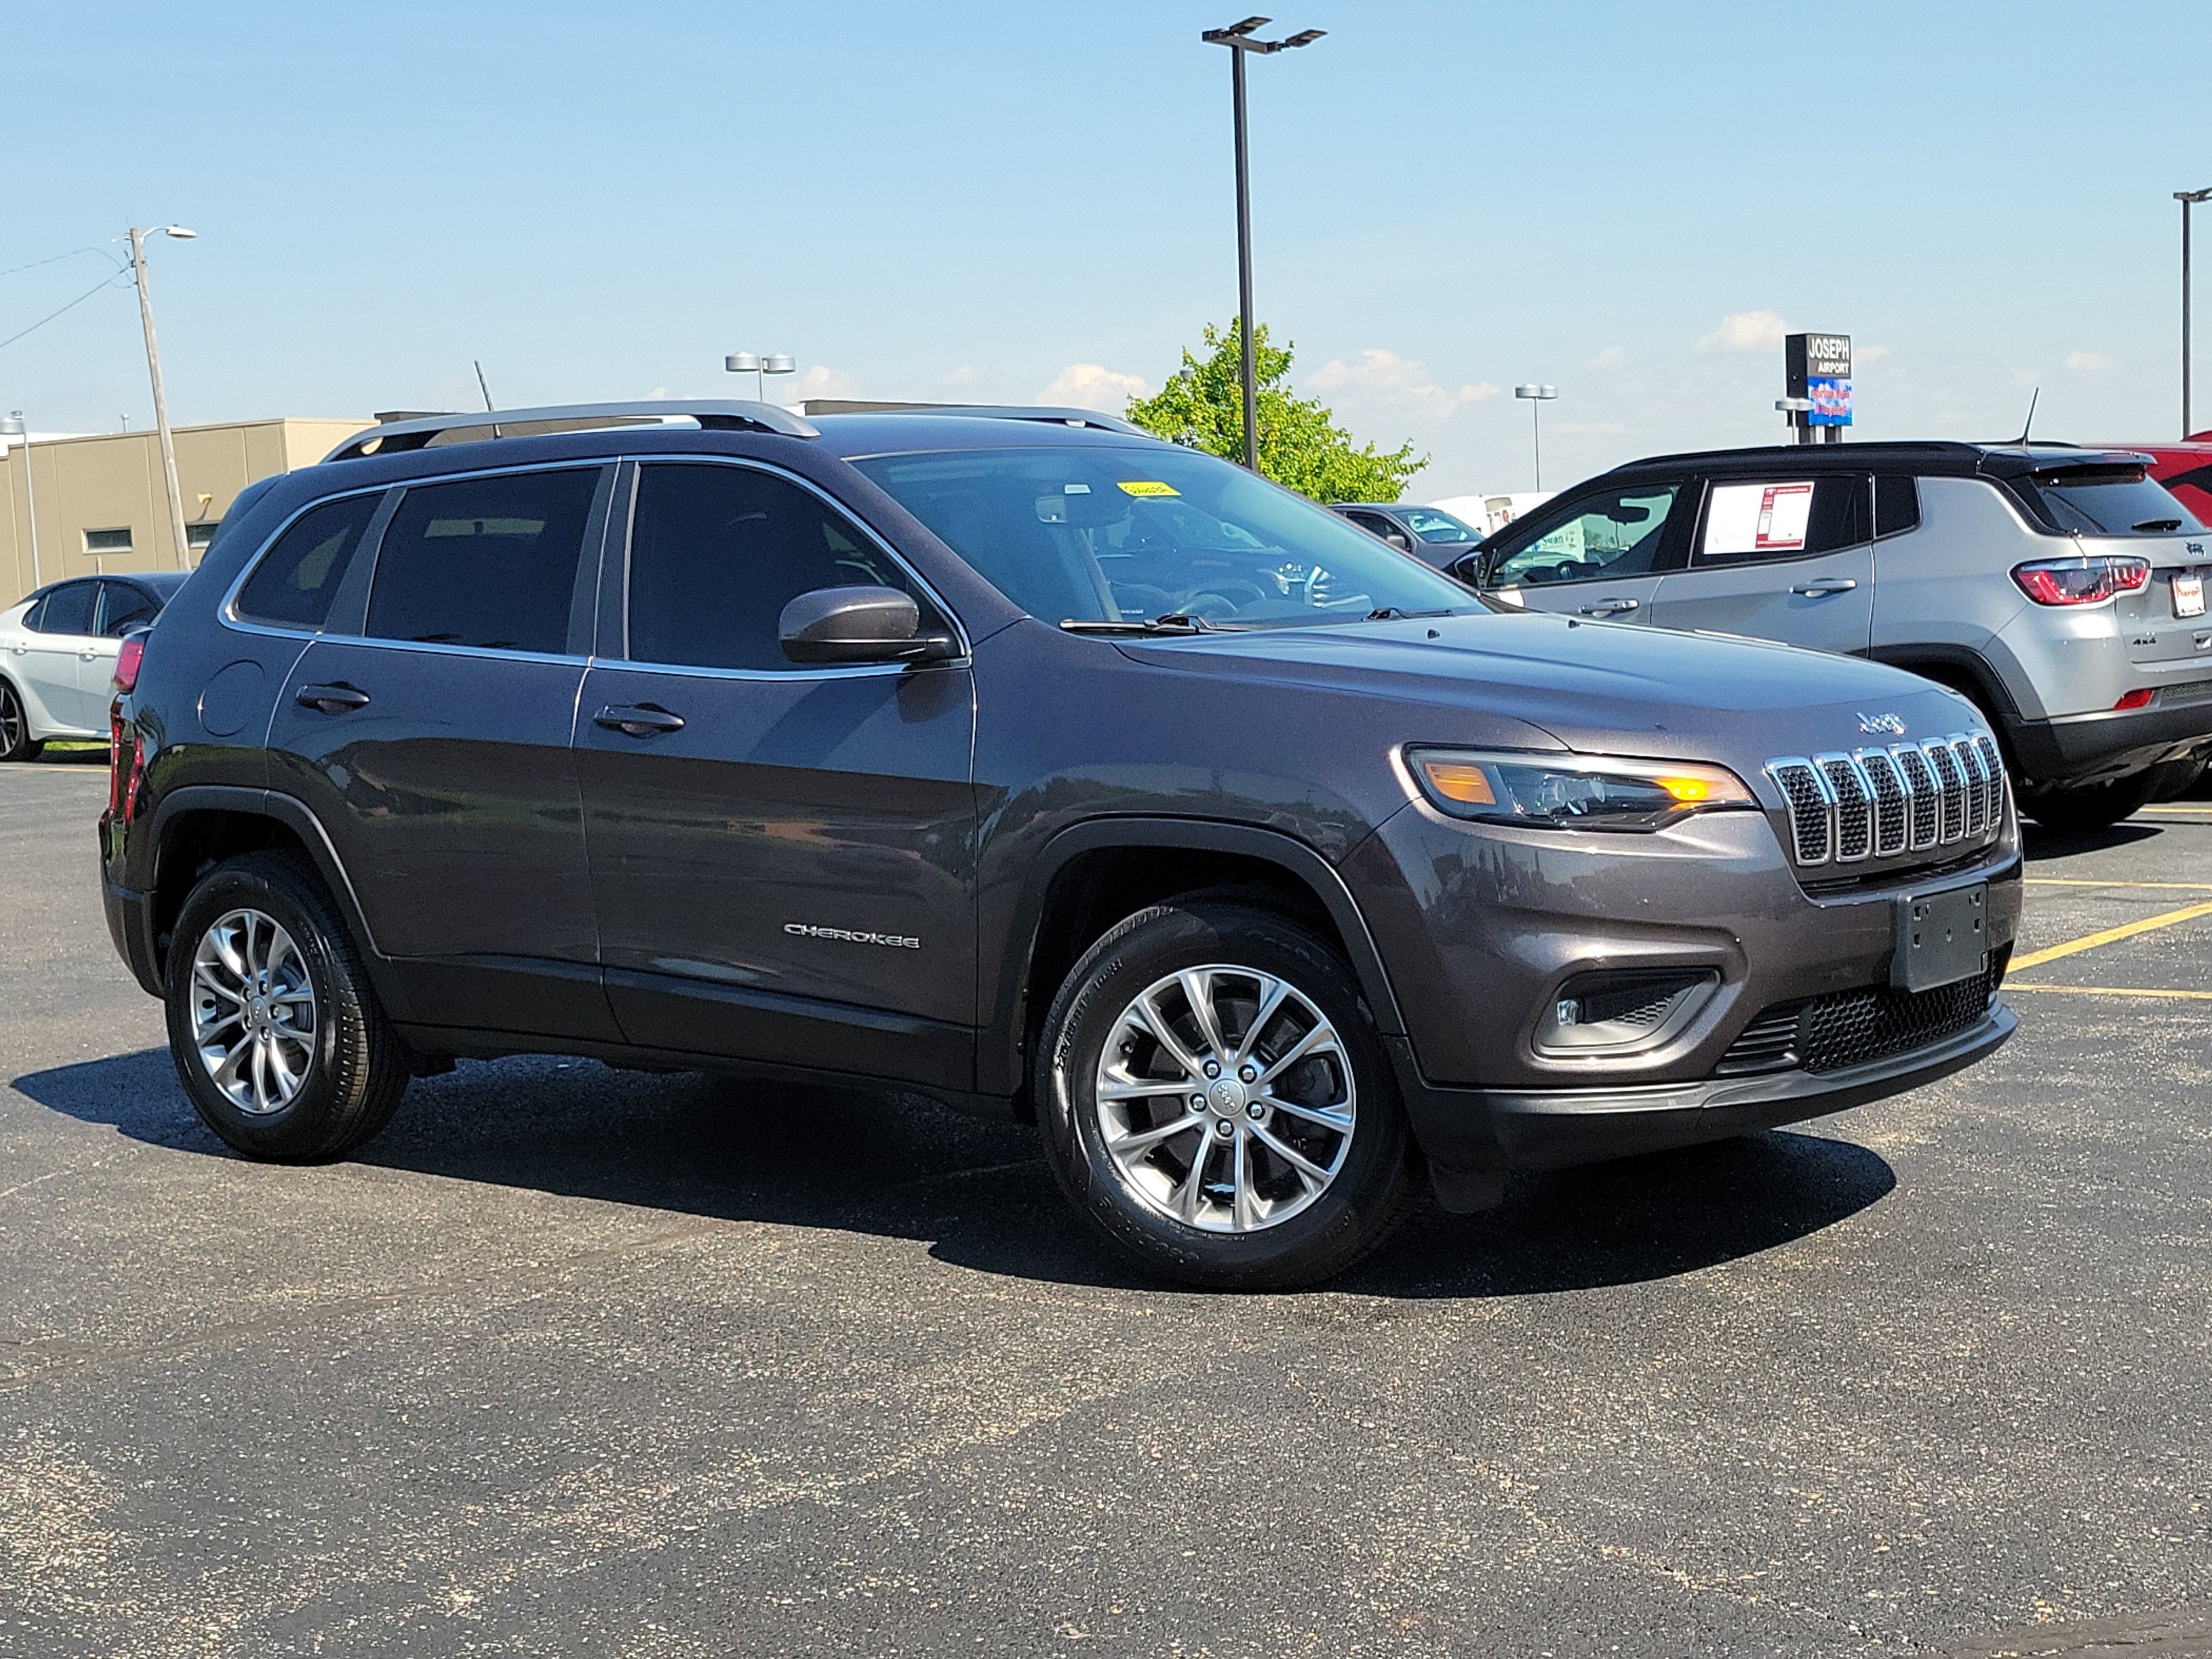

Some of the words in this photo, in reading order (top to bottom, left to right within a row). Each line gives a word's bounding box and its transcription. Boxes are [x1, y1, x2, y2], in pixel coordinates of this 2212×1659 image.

[1809, 337, 1849, 359] JOSEPH
[1818, 361, 1849, 374] AIRPORT
[1856, 712, 1906, 735] Jeep
[784, 923, 921, 949] CHEROKEE
